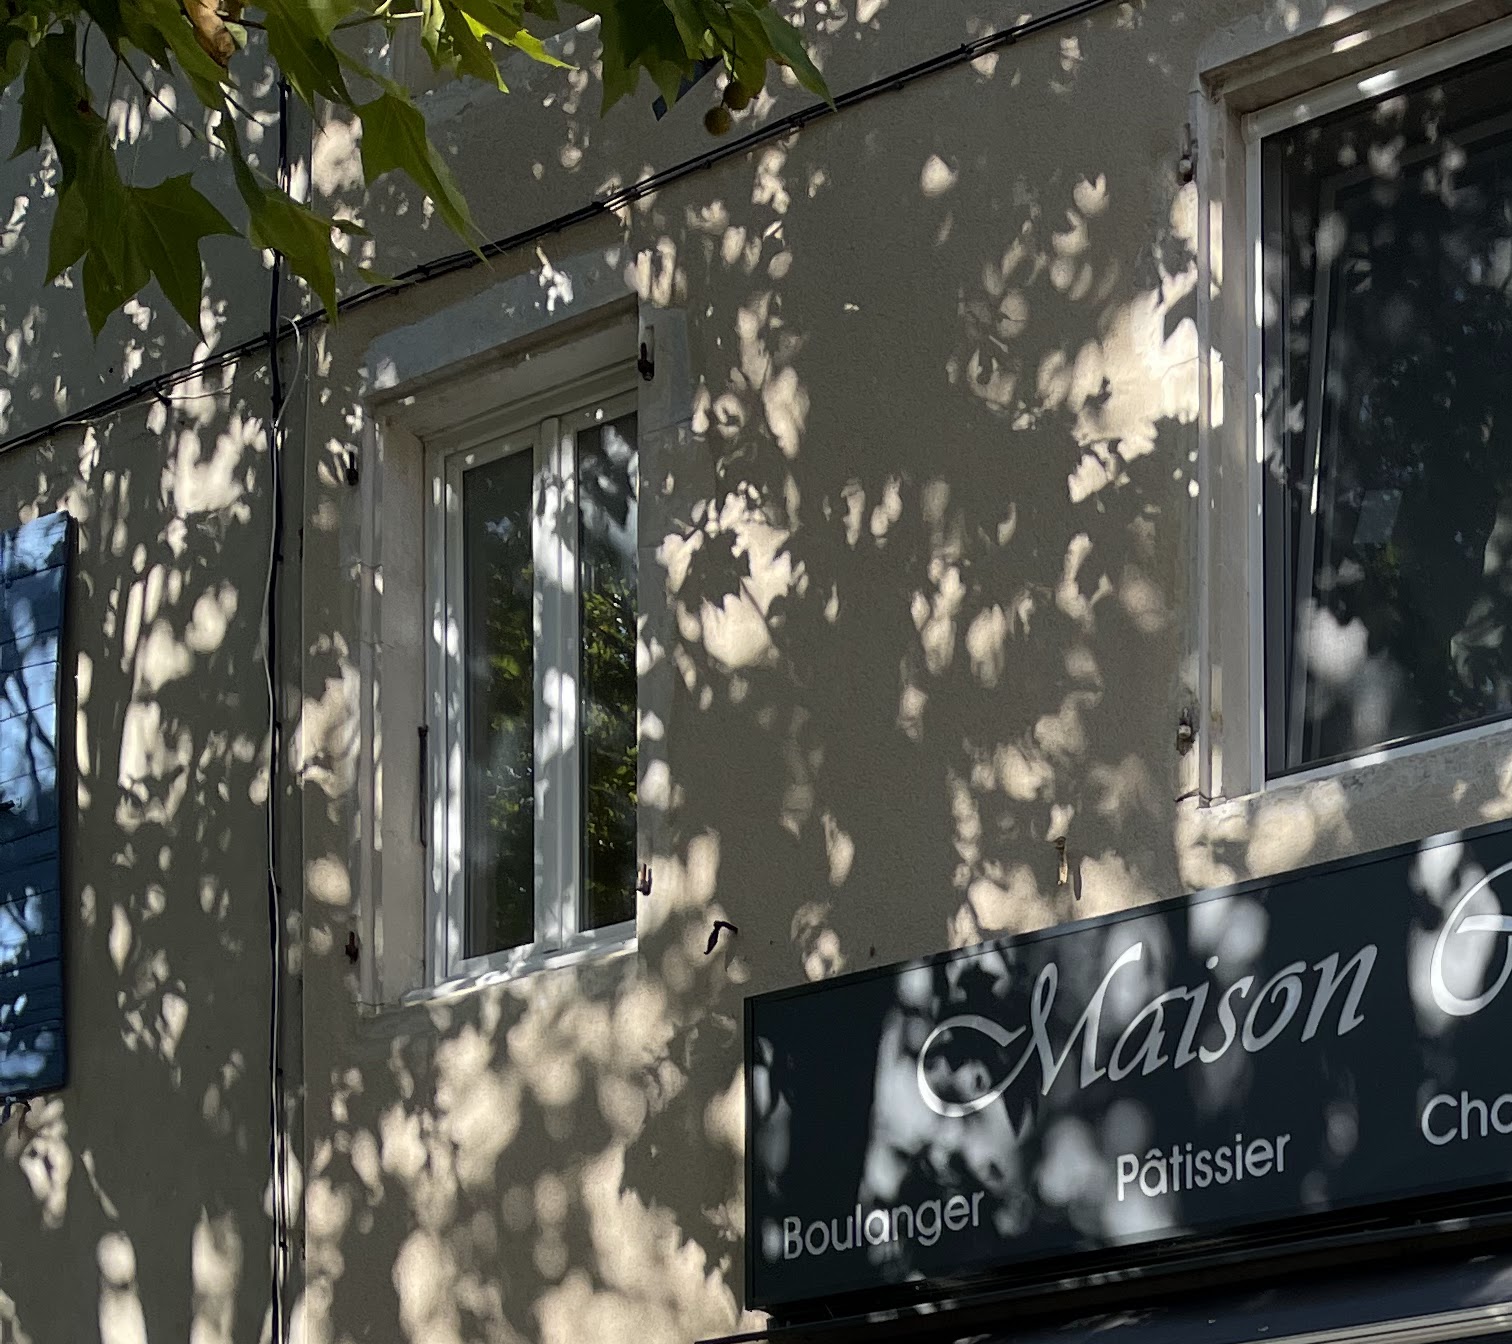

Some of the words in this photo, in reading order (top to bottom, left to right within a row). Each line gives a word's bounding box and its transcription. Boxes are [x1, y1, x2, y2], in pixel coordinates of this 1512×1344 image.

[916, 941, 1379, 1118] Maison
[781, 1189, 986, 1260] Boulanger
[1116, 1133, 1292, 1202] Pâtissier
